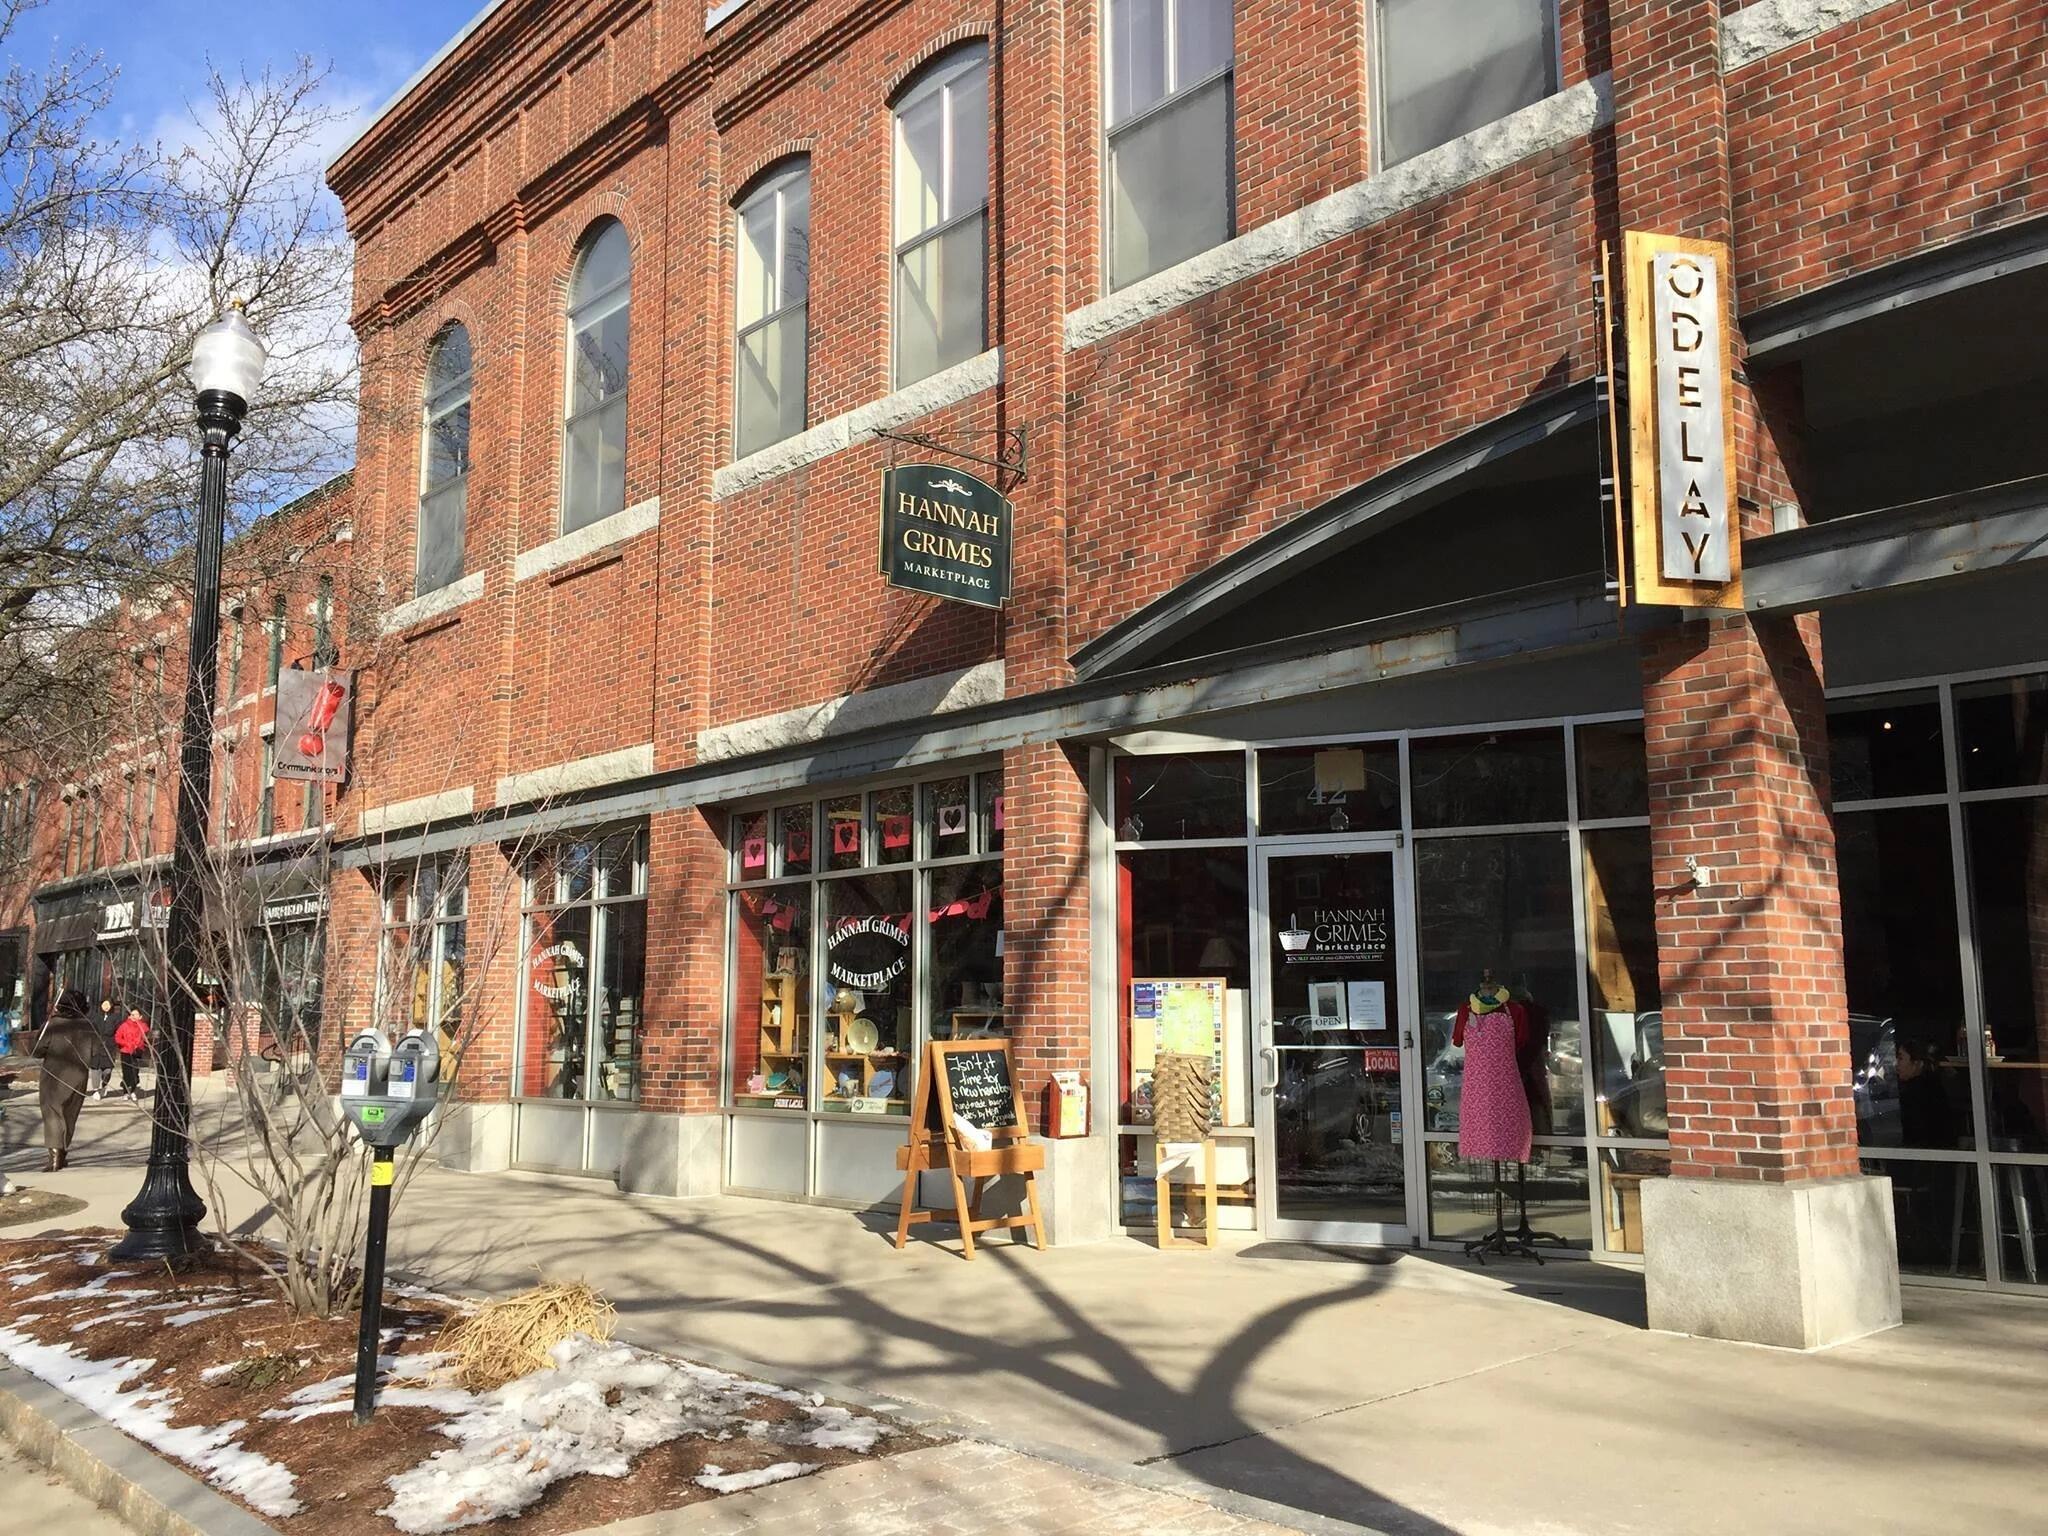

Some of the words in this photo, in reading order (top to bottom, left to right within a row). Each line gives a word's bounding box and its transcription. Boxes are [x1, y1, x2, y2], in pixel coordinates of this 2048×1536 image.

[1667, 257, 1711, 575] ODELAY
[898, 491, 999, 537] HANNAH
[903, 528, 992, 568] GRIMES
[904, 562, 991, 590] MARKETPLACE
[1307, 781, 1346, 805] 42
[1314, 908, 1385, 923] HANNAH
[827, 919, 870, 951] HANNAH
[871, 919, 910, 947] GRIMES
[1314, 923, 1387, 943] GRIMES
[1316, 942, 1386, 952] Marketplace
[831, 956, 906, 987] MARKETPLACE
[1315, 1016, 1342, 1026] OPEN
[947, 1052, 982, 1072] Isn't
[984, 1052, 996, 1069] it
[959, 1071, 982, 1086] time
[983, 1068, 999, 1084] for
[952, 1087, 959, 1099] a
[960, 1085, 978, 1098] new
